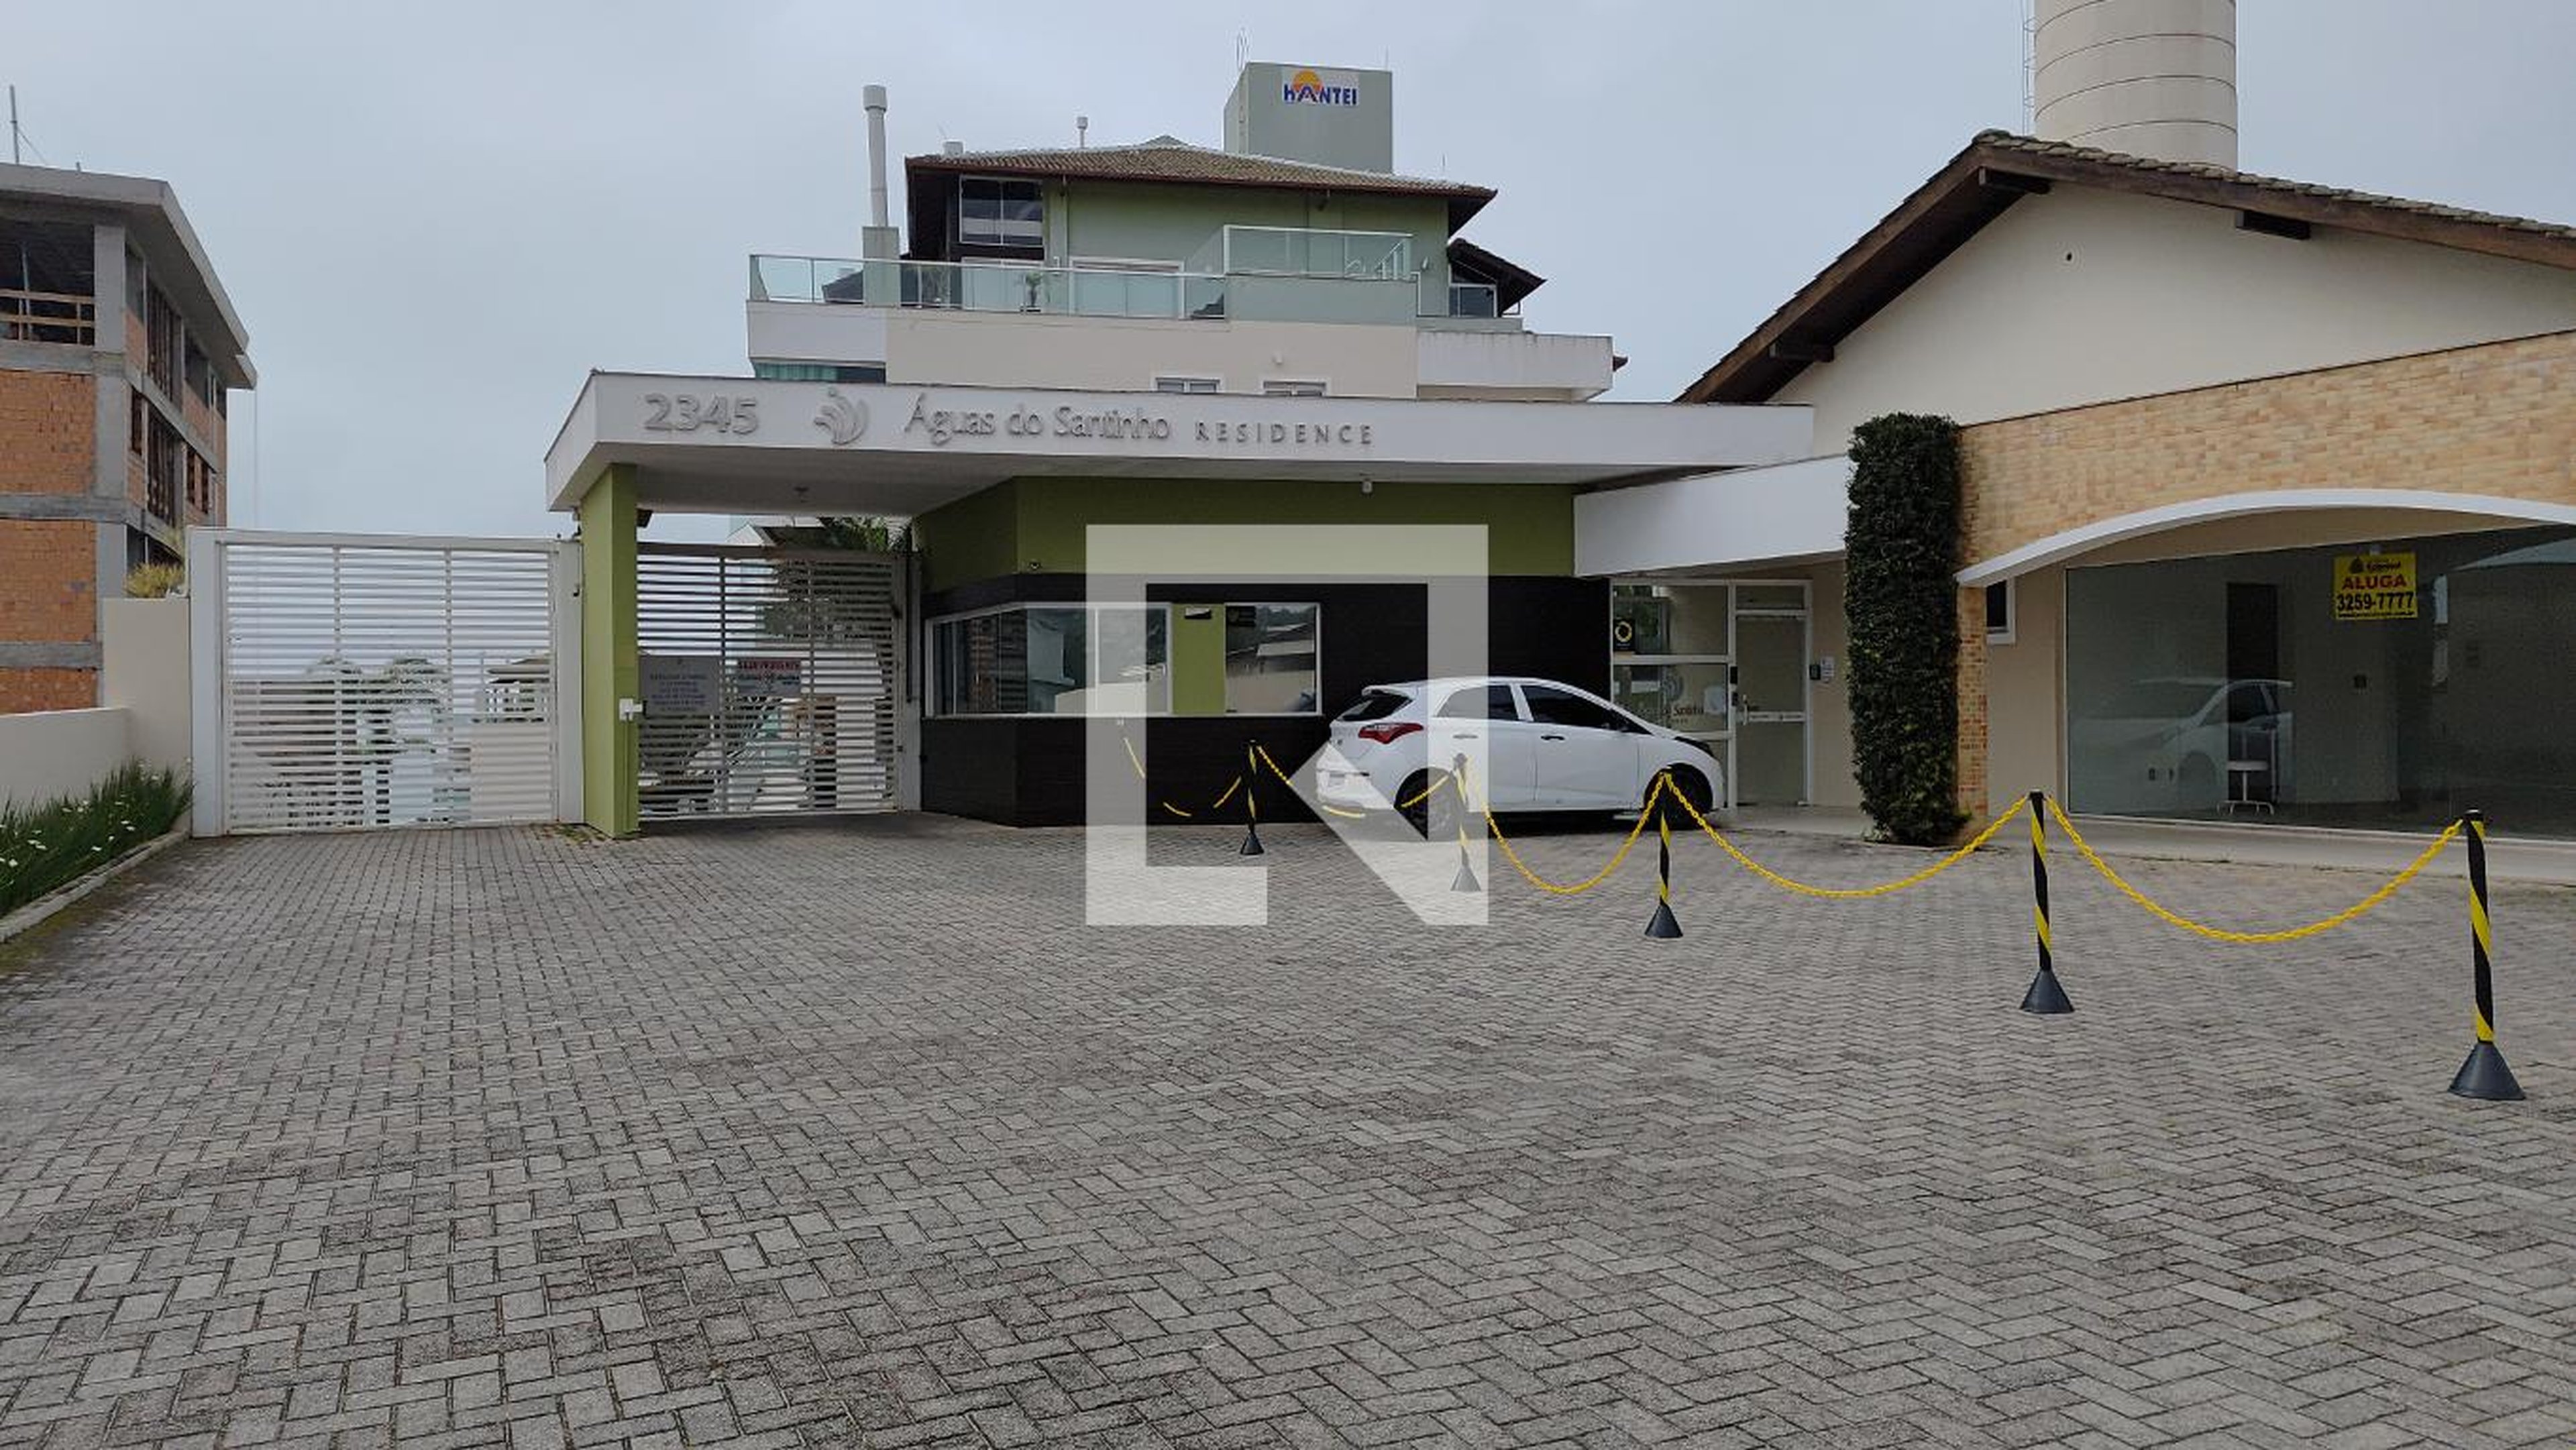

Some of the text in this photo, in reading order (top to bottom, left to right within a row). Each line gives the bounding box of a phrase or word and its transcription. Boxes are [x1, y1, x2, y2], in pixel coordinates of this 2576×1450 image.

[644, 393, 759, 435] 2345
[904, 393, 1373, 446] Águas do Santinho RESIDENCE
[2342, 575, 2406, 590] ALUGA
[2337, 592, 2414, 611] 3259-7777
